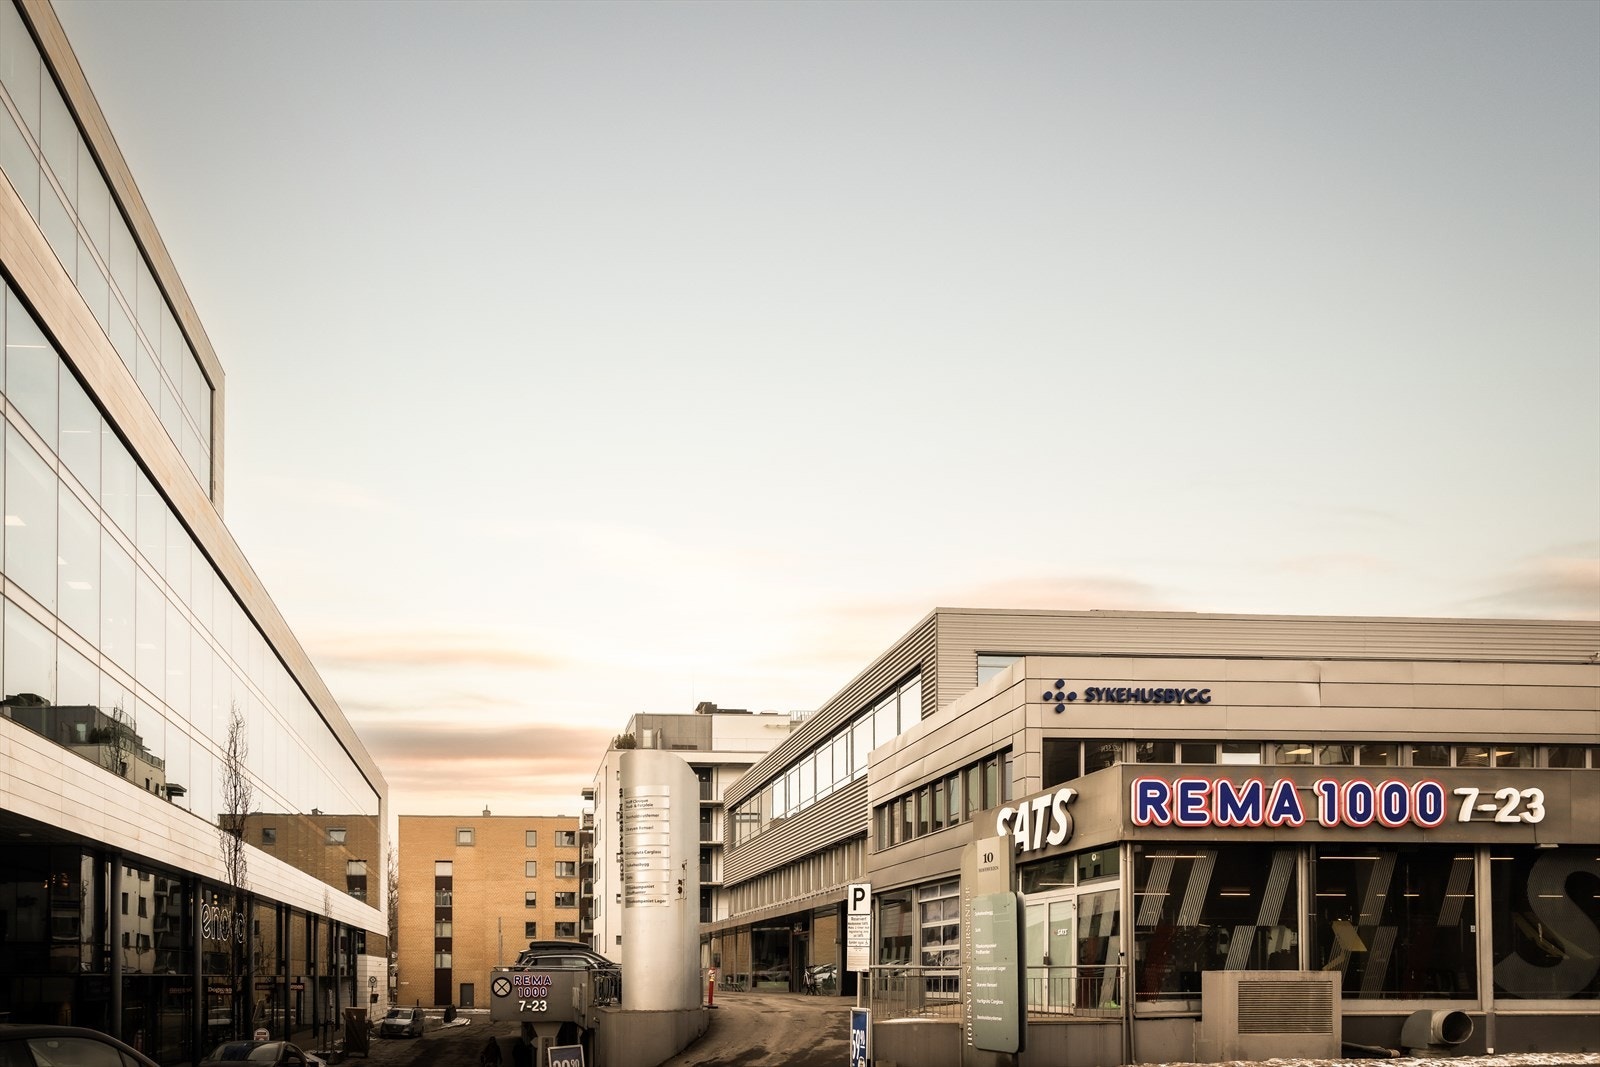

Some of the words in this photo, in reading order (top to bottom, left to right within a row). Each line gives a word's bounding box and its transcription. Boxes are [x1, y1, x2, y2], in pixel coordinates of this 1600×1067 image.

[1084, 686, 1212, 705] SYKEHUSBYGG
[1130, 776, 1306, 828] REMA
[1313, 778, 1448, 829] 1000
[1453, 786, 1546, 825] 7-23
[996, 788, 1078, 853] SATS
[983, 852, 994, 864] 10
[853, 887, 866, 911] P
[513, 975, 552, 986] REMA
[517, 986, 548, 998] 1000
[518, 1000, 548, 1012] 7-23
